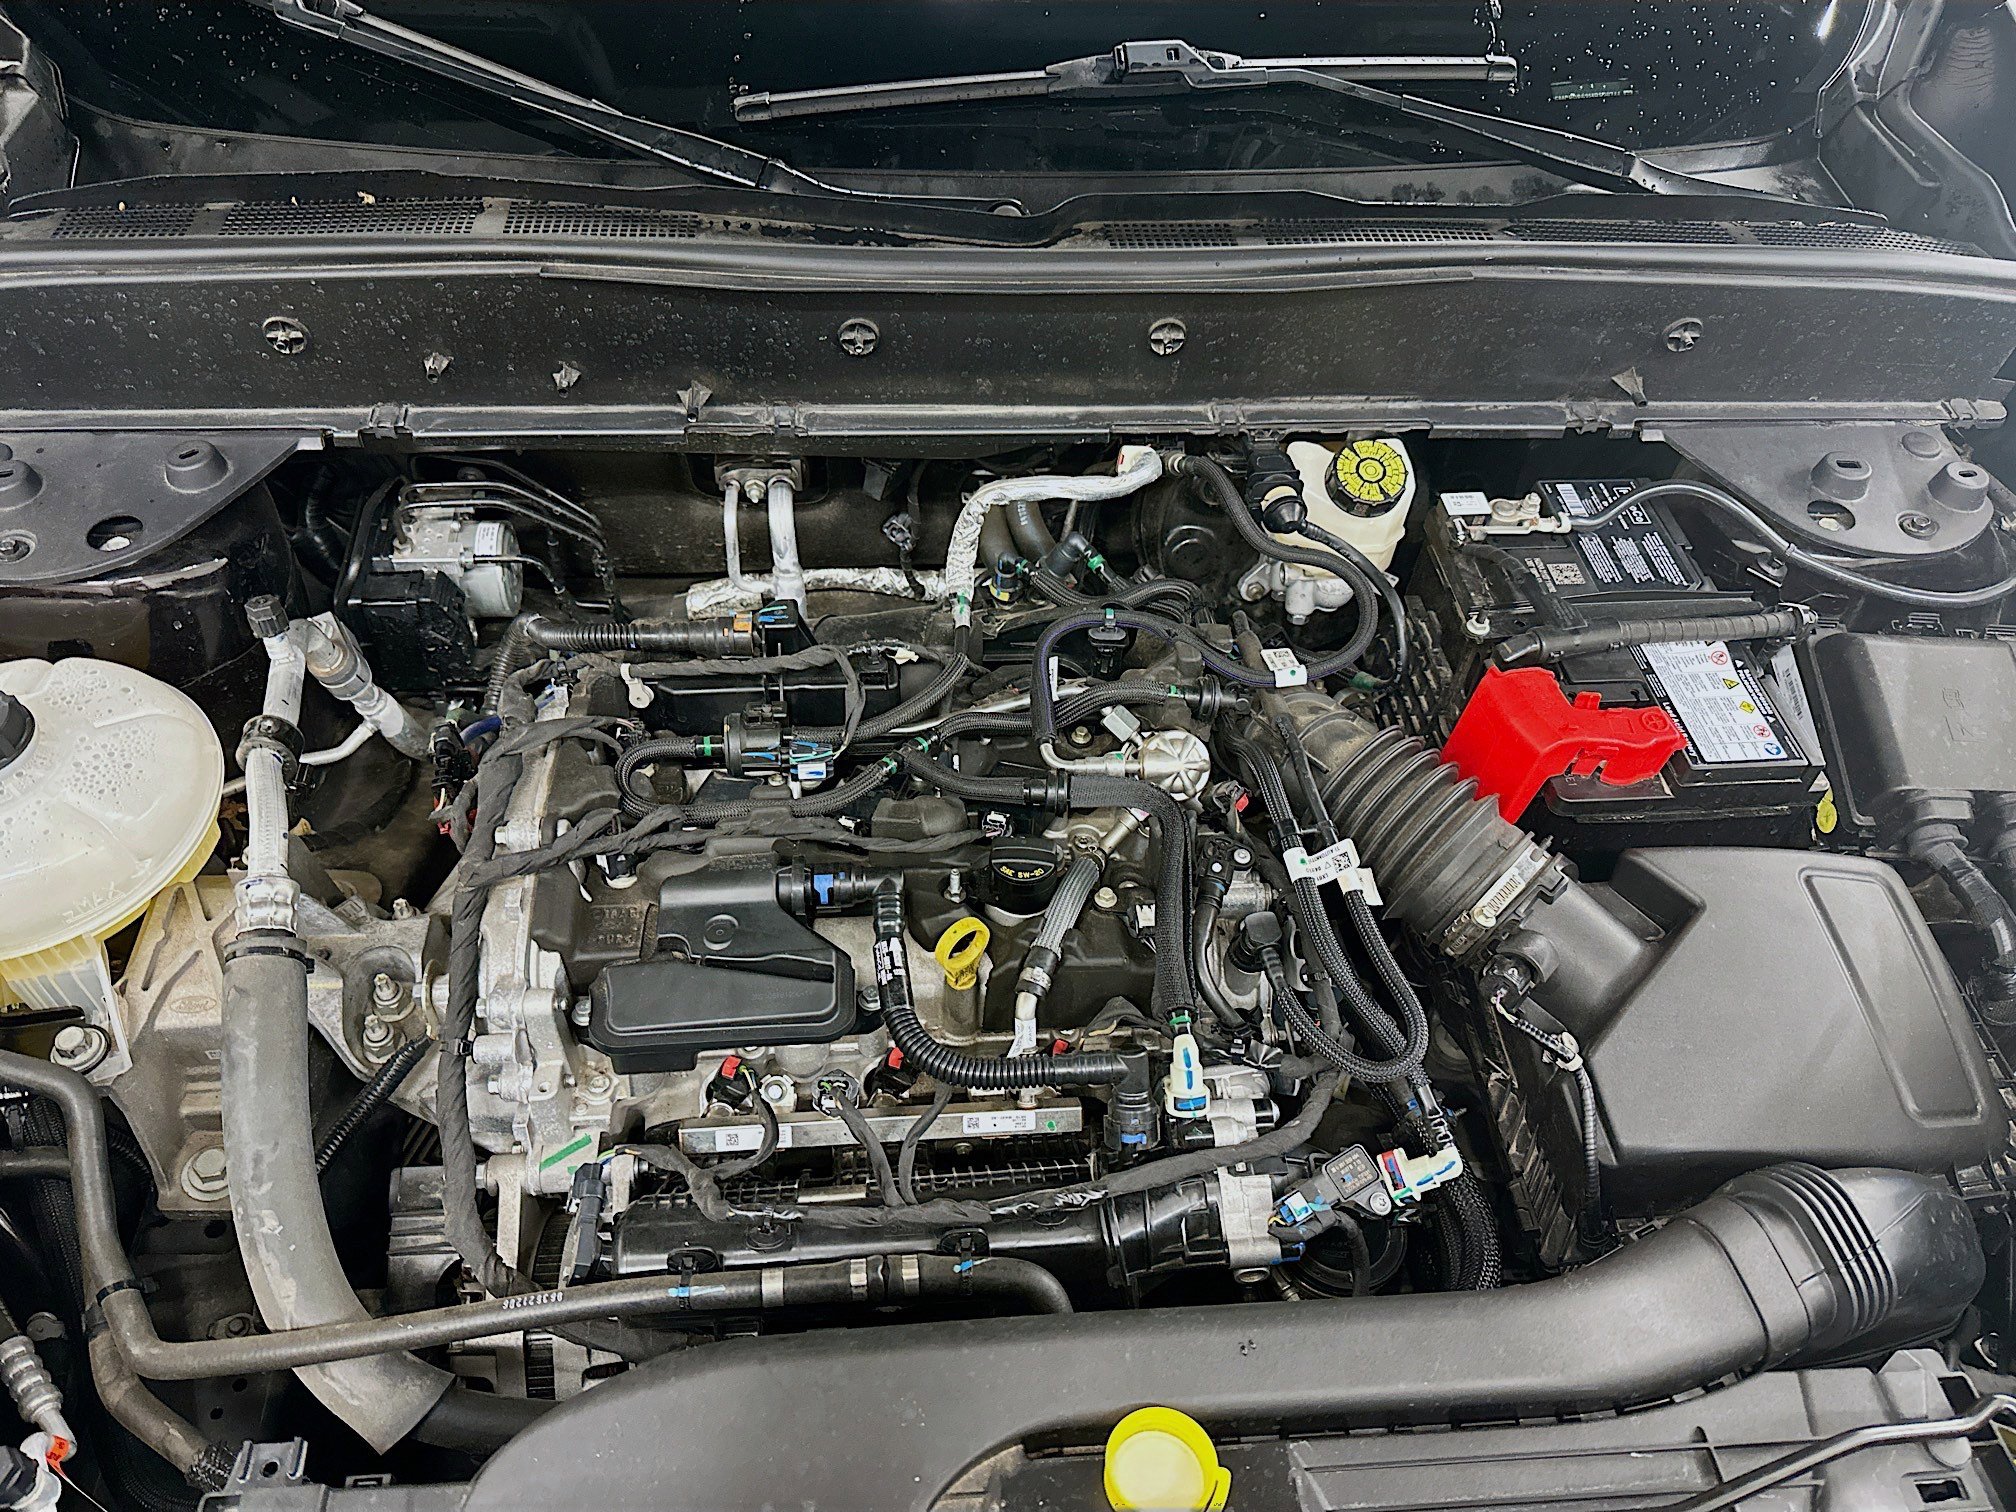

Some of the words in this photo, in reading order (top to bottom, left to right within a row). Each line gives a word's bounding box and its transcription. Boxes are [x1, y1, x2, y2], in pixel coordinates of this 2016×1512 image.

[1662, 702, 1677, 718] Lead
[1000, 865, 1015, 877] SAE
[1017, 867, 1045, 878] 5W-20
